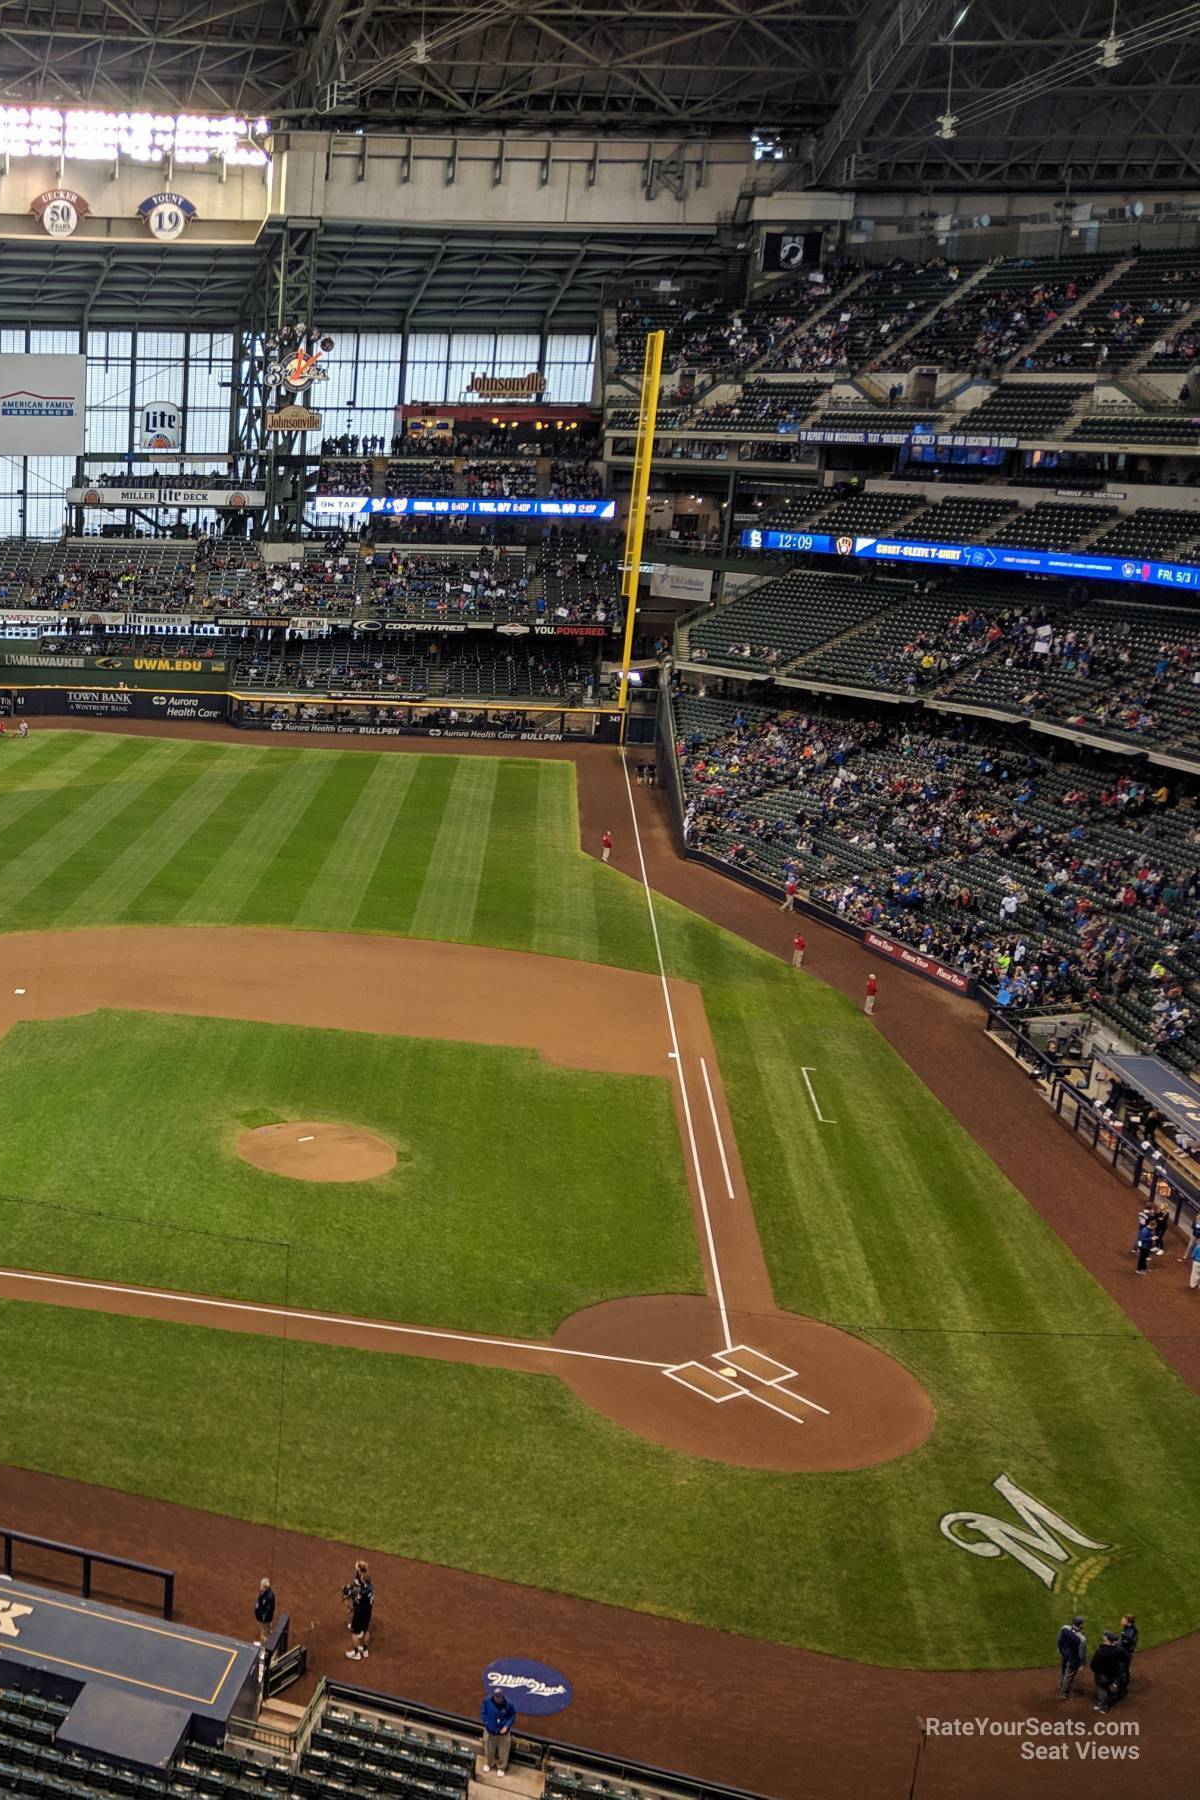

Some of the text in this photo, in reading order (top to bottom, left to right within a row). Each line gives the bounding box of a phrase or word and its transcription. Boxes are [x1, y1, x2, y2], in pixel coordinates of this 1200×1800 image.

[41, 191, 78, 204] UECKER
[151, 194, 185, 206] YOUNT
[50, 205, 71, 222] 50
[155, 211, 179, 232] 19
[466, 371, 547, 393] Johnsonville
[1, 401, 74, 409] AMERICAN FAMILY
[144, 411, 176, 433] Lite
[268, 415, 320, 429] Johnsonville
[824, 432, 834, 442] FAN
[867, 433, 880, 443] TEXT
[121, 489, 209, 507] MILLER Lite DECK
[1056, 489, 1125, 499] FAMILY SECTION
[320, 501, 335, 509] ON
[337, 501, 358, 509] TAP
[778, 534, 813, 549] 12:09
[875, 544, 930, 559] SHORT-SLEEVE
[930, 548, 961, 560] T-SHIRT
[1176, 570, 1191, 584] 5/3
[145, 616, 176, 624] BEERPEN
[218, 618, 251, 626] WISCONSIN'S
[268, 619, 289, 627] STATION
[133, 660, 202, 672] UWM.EDU
[67, 692, 132, 703] TOWN BANK
[168, 697, 199, 707] Aurora
[166, 708, 219, 718] Health Care
[608, 715, 621, 723] 345
[284, 723, 400, 736] Aurora Health Care BULLPEN
[442, 728, 563, 742] Aurora Health Care BULLPEN
[488, 1672, 567, 1697] Miller Park
